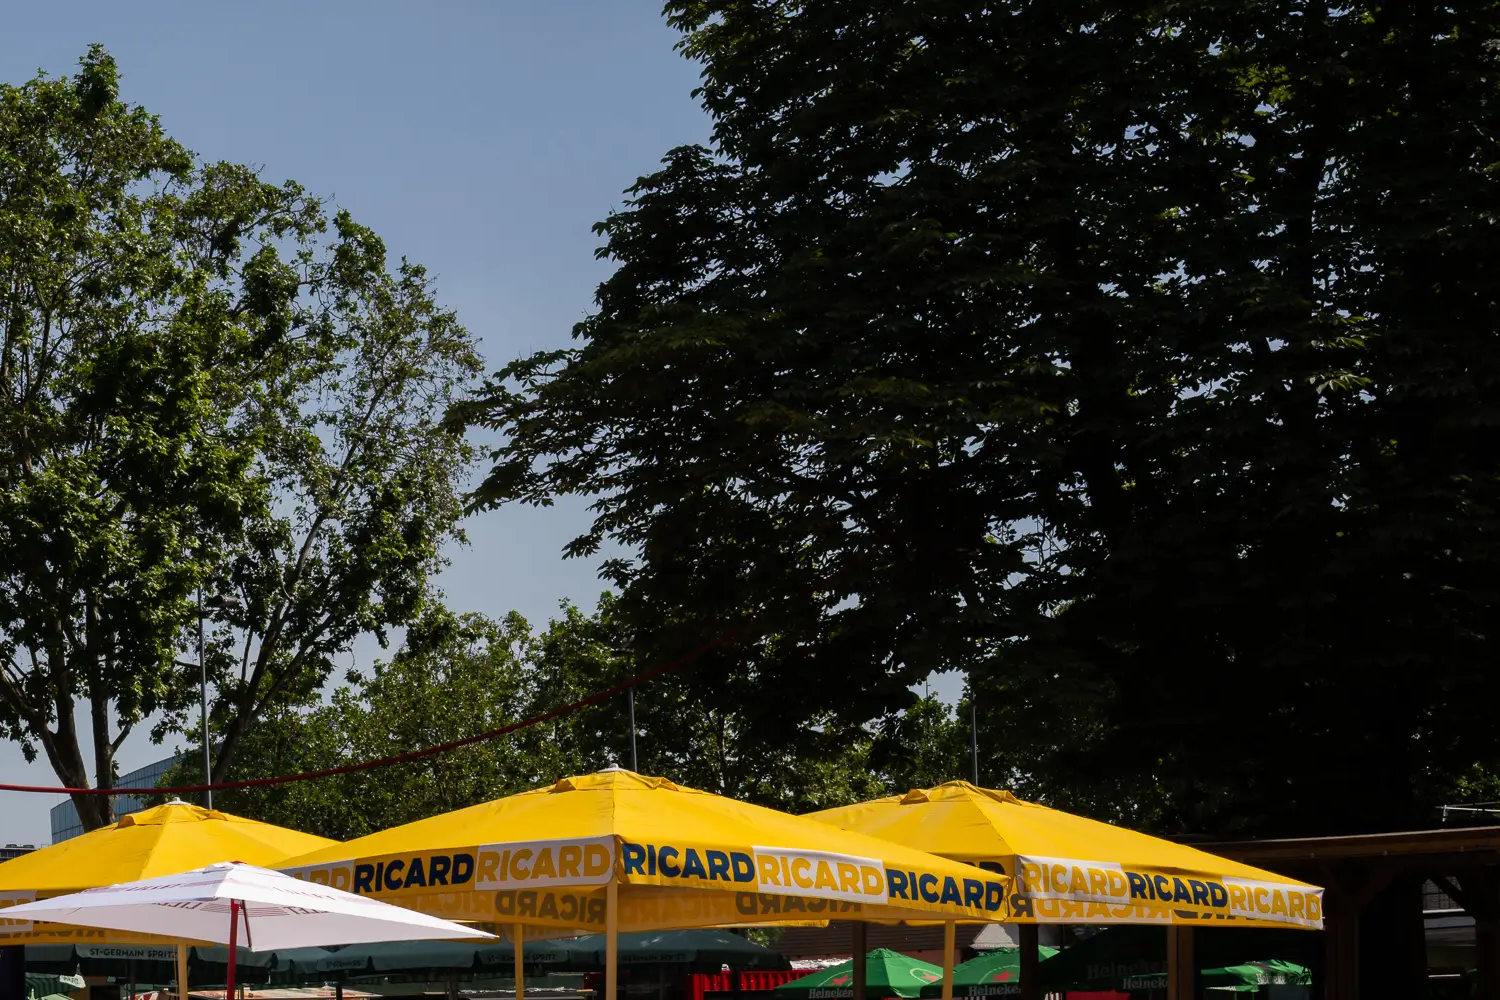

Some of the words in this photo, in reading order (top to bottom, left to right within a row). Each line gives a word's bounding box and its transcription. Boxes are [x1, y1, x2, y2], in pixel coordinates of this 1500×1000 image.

[353, 853, 475, 892] RICARD
[477, 844, 611, 882] RICARD
[621, 843, 755, 882] RICARD
[756, 854, 885, 896] RICARD
[1022, 862, 1128, 897] RICARD
[885, 868, 1004, 911] RICARD
[1124, 871, 1228, 908] RICARD
[1226, 883, 1322, 921] RICARD
[90, 948, 144, 957] ST-GERMAIN
[147, 950, 178, 958] SPRITZ
[968, 983, 1021, 997] Heineke
